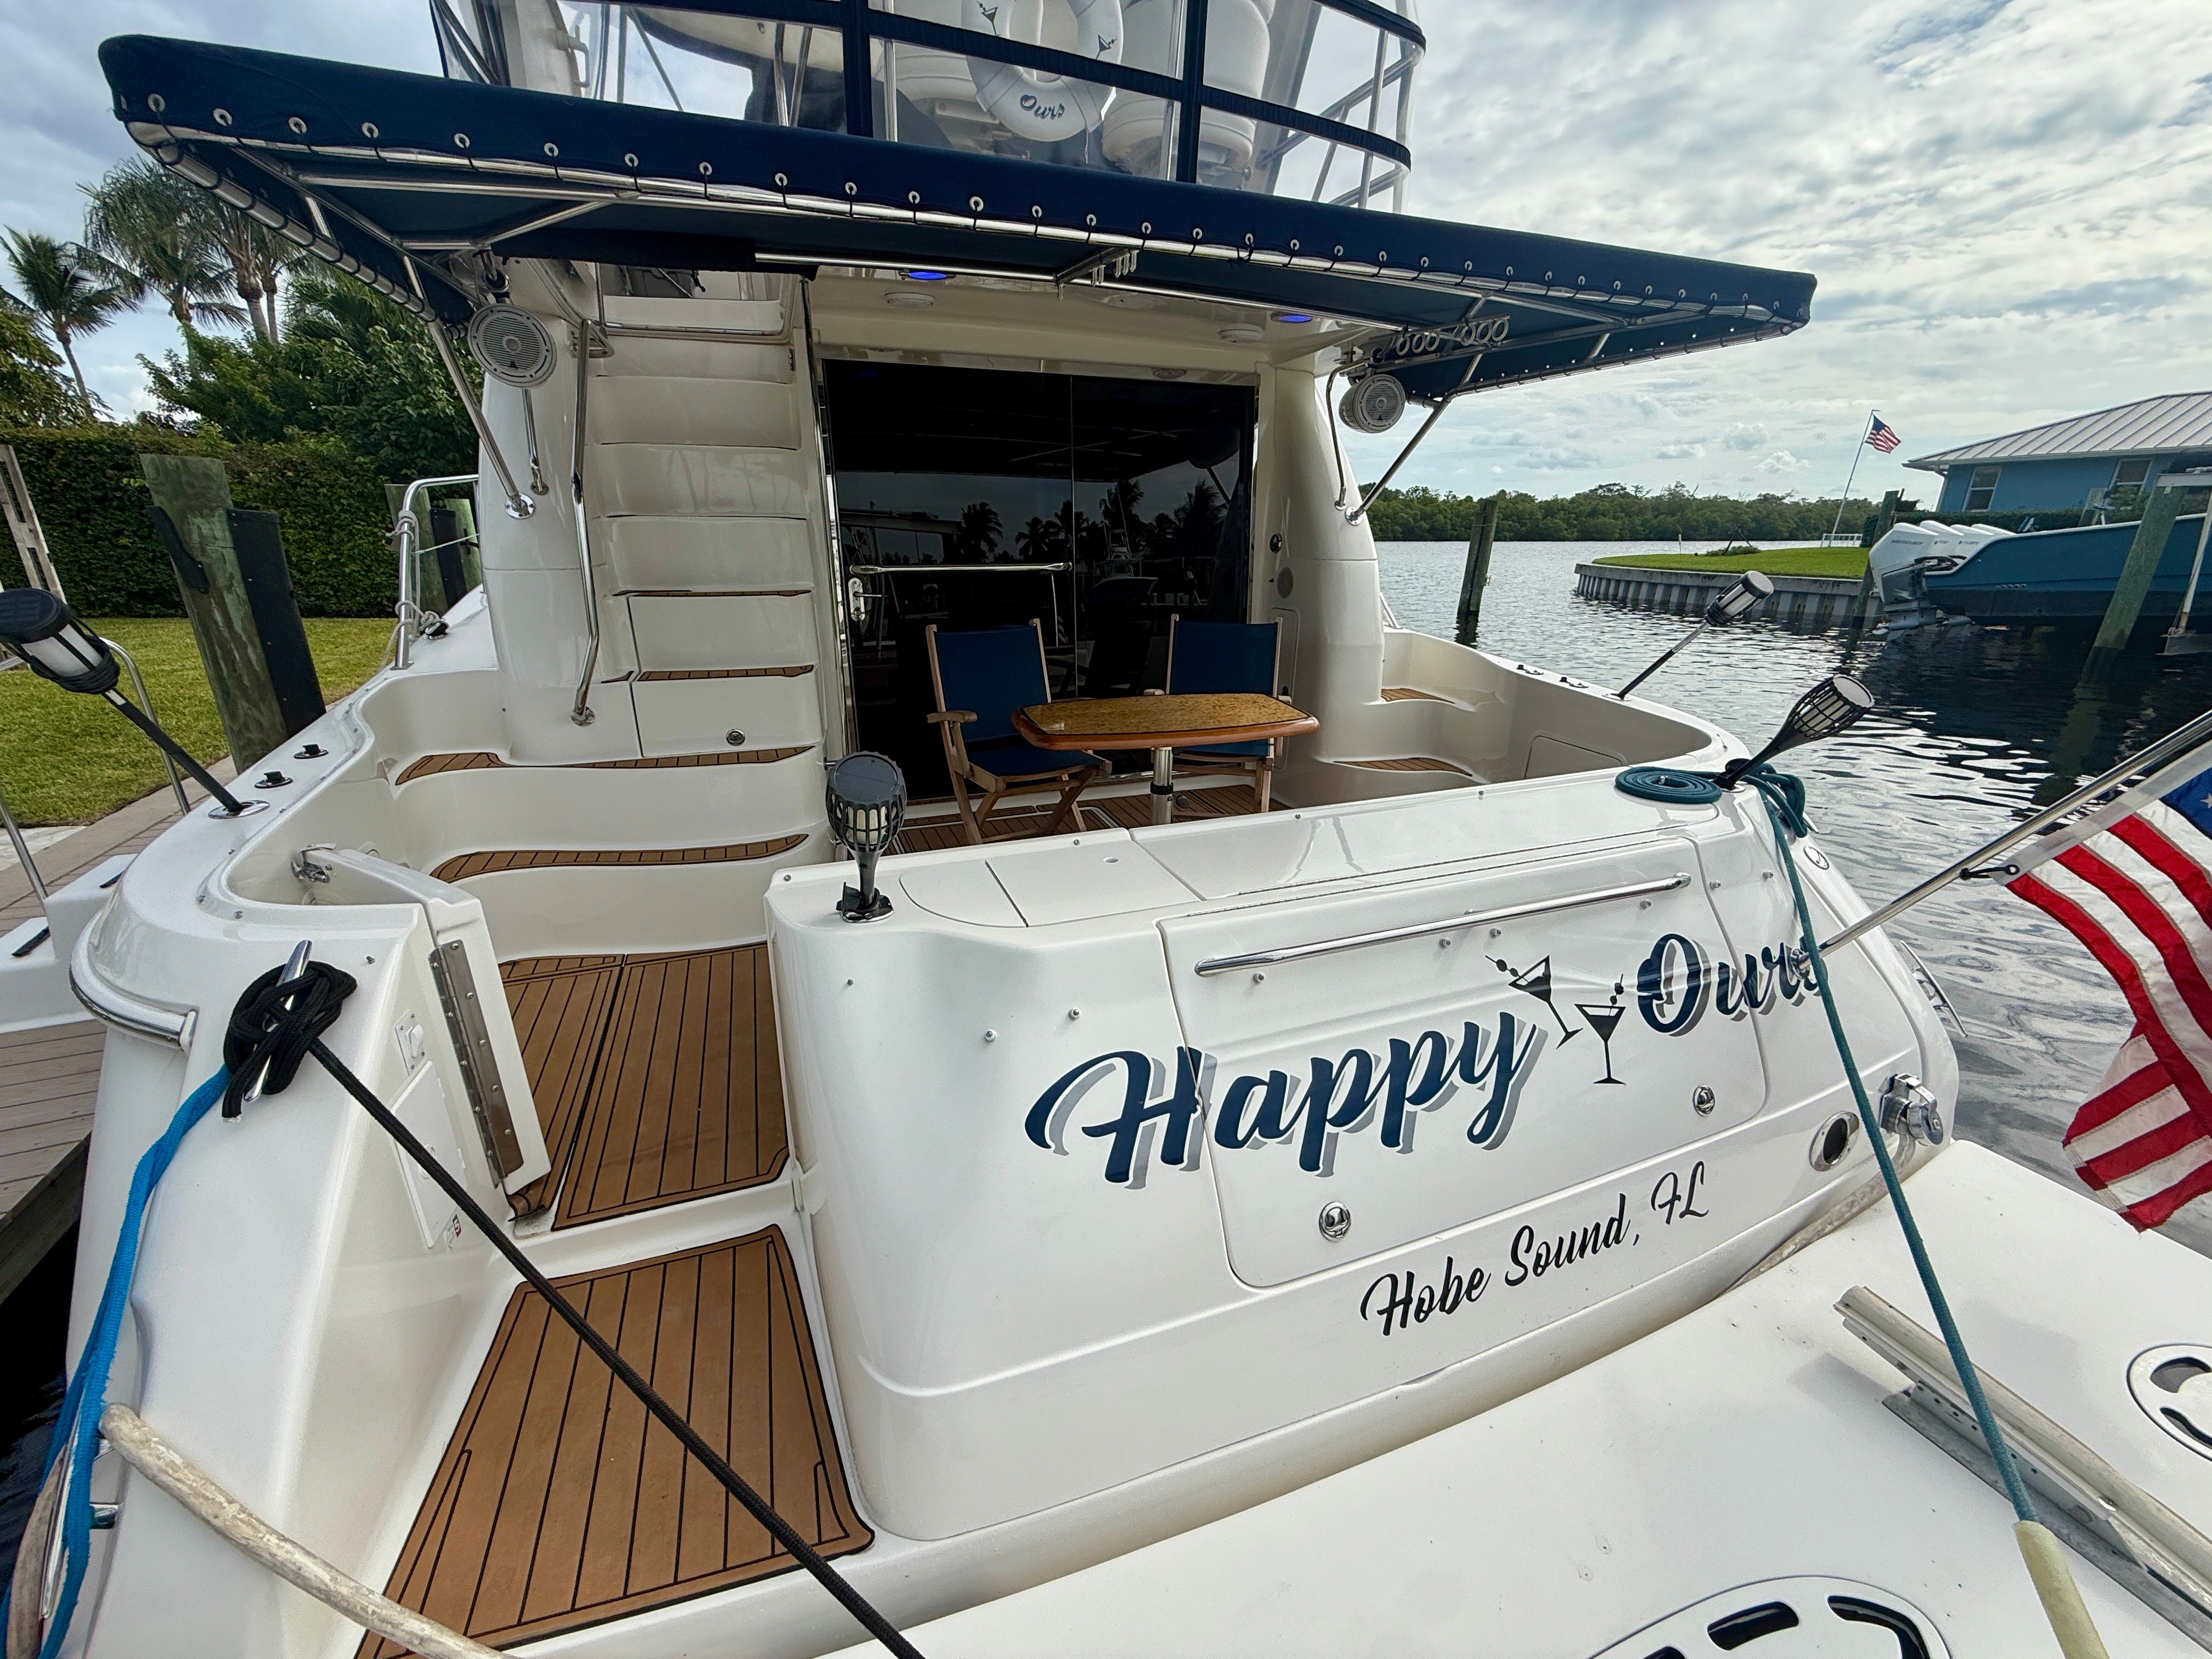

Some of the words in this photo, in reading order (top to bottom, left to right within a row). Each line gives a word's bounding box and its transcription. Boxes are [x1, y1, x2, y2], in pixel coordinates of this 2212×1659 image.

[1020, 94, 1065, 120] Ours
[1024, 1011, 1544, 1188] Happy
[1359, 1256, 1492, 1336] Hobe
[1504, 1192, 1640, 1287] Sound,
[1650, 1160, 1709, 1225] FL
